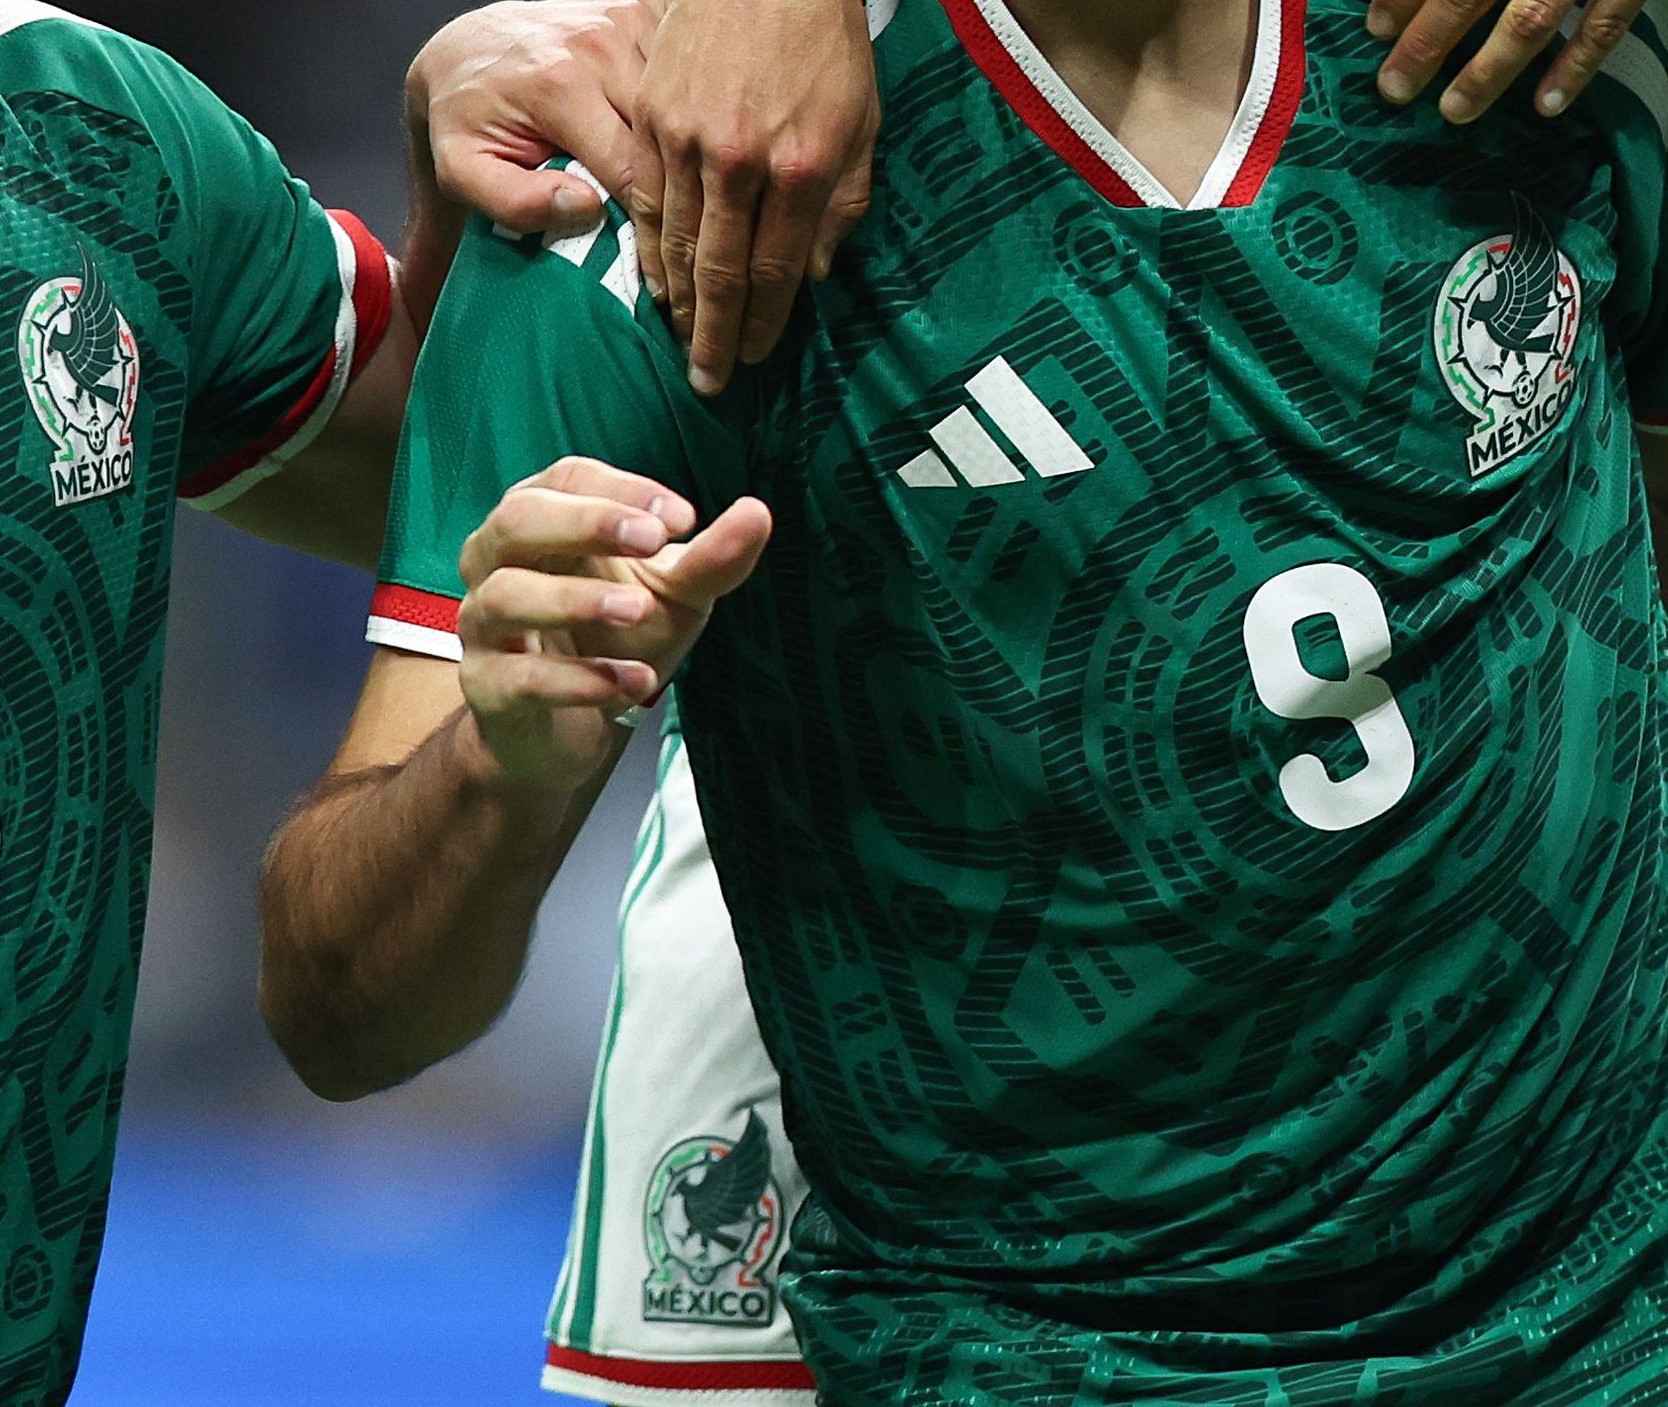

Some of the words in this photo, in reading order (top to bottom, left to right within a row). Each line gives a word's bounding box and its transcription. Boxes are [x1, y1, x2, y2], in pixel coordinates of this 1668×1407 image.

[1471, 384, 1572, 470] MÉXICO
[55, 451, 132, 500] MÉXICO
[1243, 563, 1415, 831] 9
[649, 1284, 765, 1317] MÉXICO
